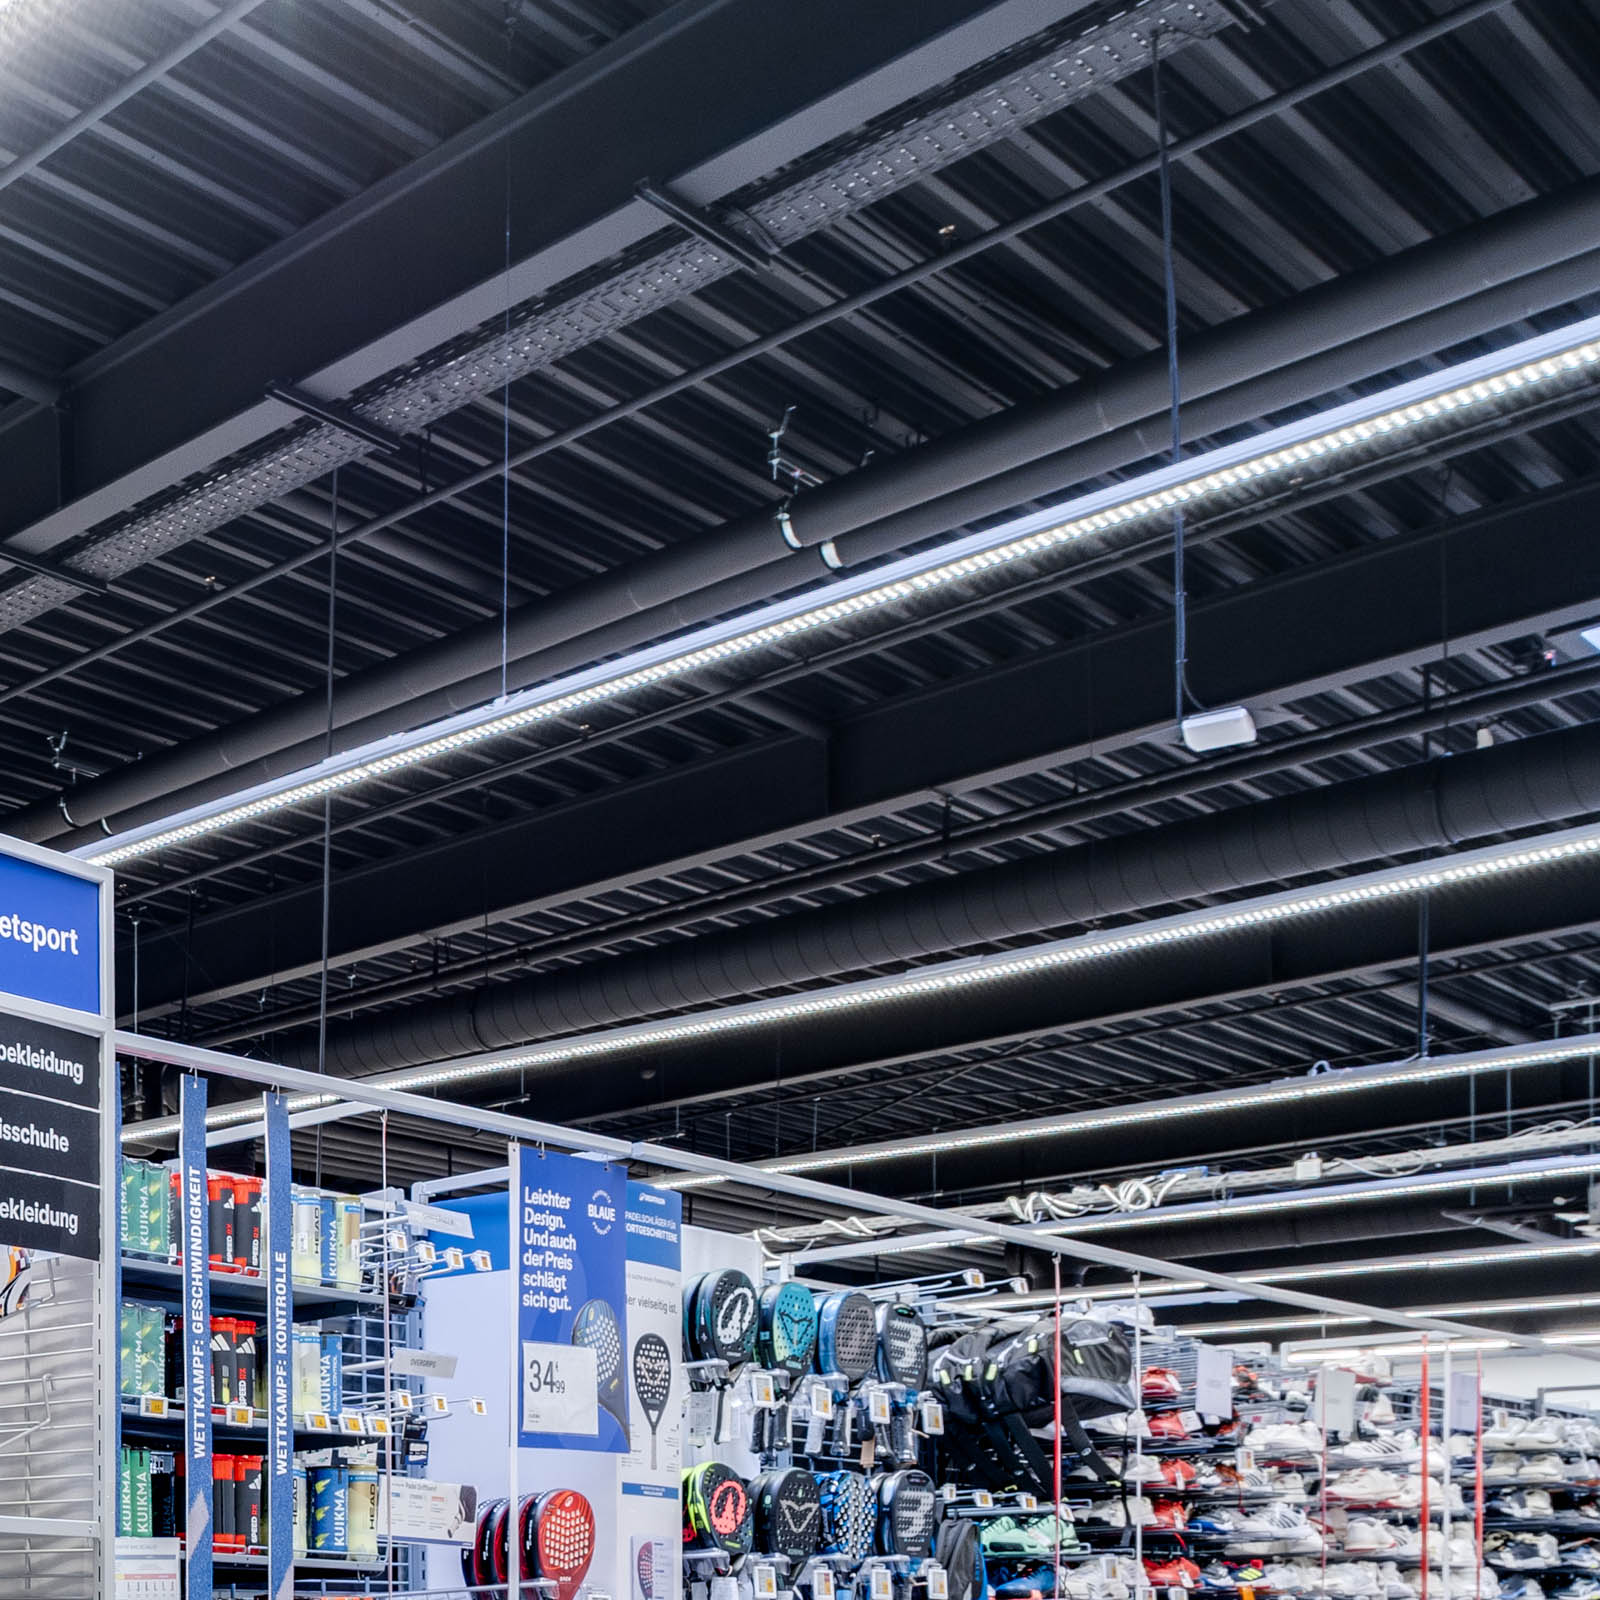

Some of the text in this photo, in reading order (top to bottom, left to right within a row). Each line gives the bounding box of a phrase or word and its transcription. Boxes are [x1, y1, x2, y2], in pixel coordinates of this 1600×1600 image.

[524, 1187, 571, 1210] Leichtes
[587, 1205, 616, 1222] BLAUE
[140, 1186, 150, 1247] KUIKMA
[524, 1209, 566, 1229] Design.
[329, 1220, 337, 1277] KUIKMA
[524, 1229, 577, 1251] Und auch
[625, 1223, 678, 1245] ORTGESCHRITTENE
[523, 1250, 573, 1271] der Preis
[523, 1272, 567, 1293] schlägt
[188, 1166, 206, 1459] WETTKAMPF: GESCHWINDIGKEIT
[523, 1291, 572, 1313] sich gut.
[135, 1331, 143, 1390] KUIKMA
[275, 1252, 288, 1476] WETTKAMPF: KONTROLLE
[528, 1360, 554, 1394] 34
[321, 1354, 331, 1413] KUIKMA
[122, 1470, 131, 1532] KUIKMA
[137, 1471, 148, 1533] KUIKMA
[334, 1488, 346, 1547] KUIKMA
[251, 1516, 259, 1544] SPEED
